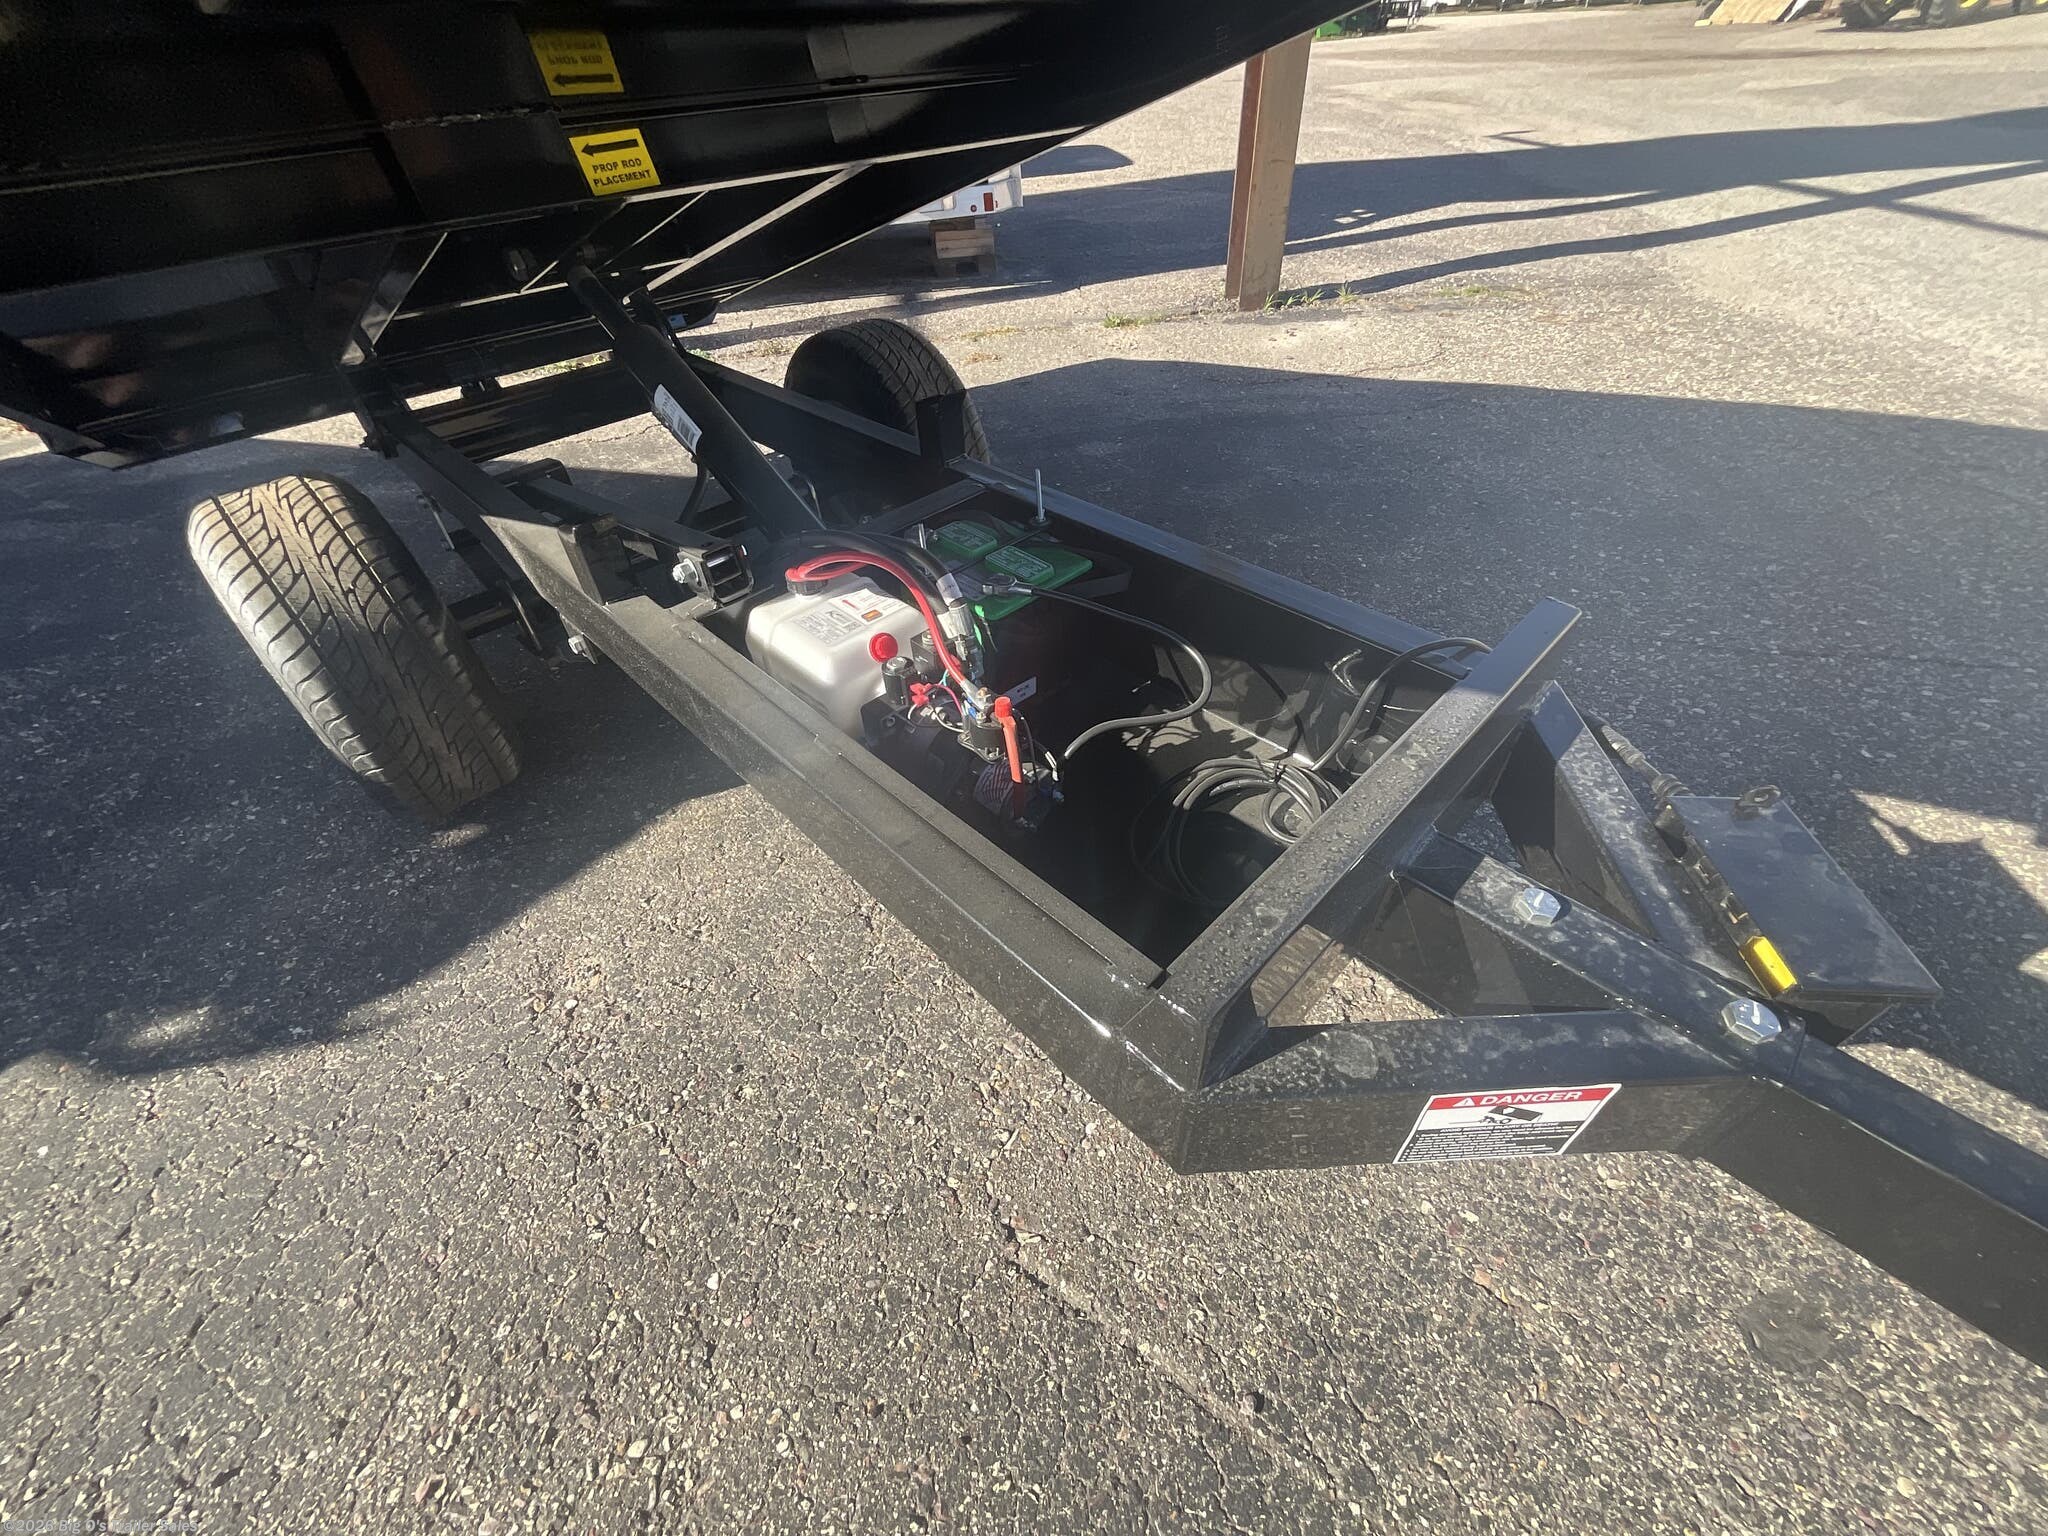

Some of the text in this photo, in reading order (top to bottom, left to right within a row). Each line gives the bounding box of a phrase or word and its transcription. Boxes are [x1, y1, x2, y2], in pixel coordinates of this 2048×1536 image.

[592, 158, 642, 174] PROP ROD
[593, 169, 652, 187] PLACEMENT
[1479, 1091, 1583, 1105] DANGER
